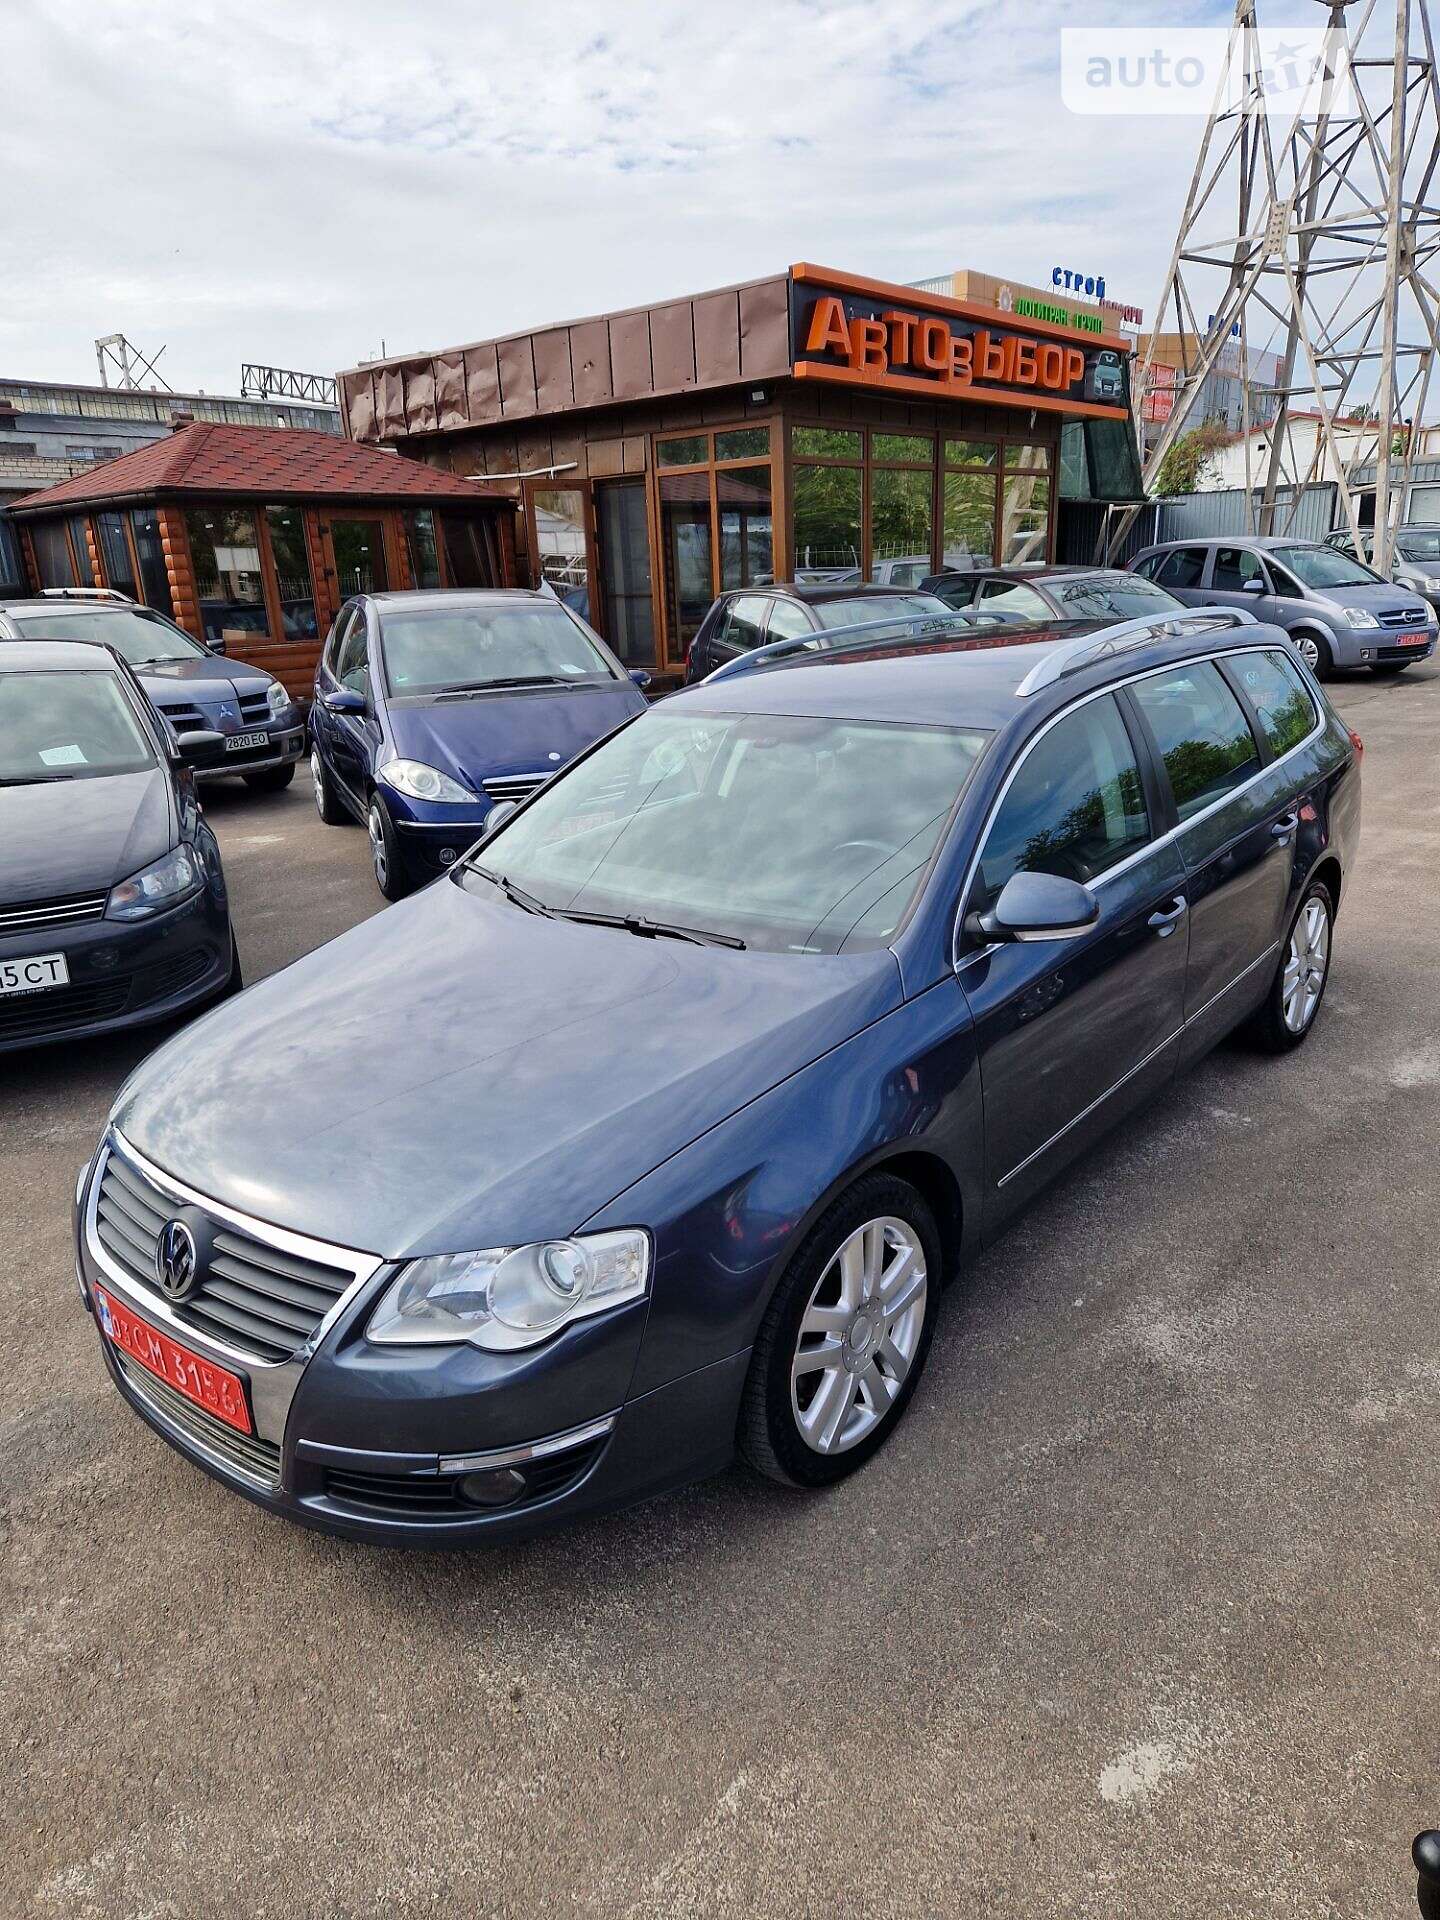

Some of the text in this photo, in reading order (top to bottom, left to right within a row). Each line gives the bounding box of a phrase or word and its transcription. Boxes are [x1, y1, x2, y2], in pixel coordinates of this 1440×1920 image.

[1053, 267, 1106, 298] СТРОЙ
[227, 733, 265, 749] 2820 EO
[24, 959, 60, 984] CT
[169, 1348, 238, 1416] 3156
